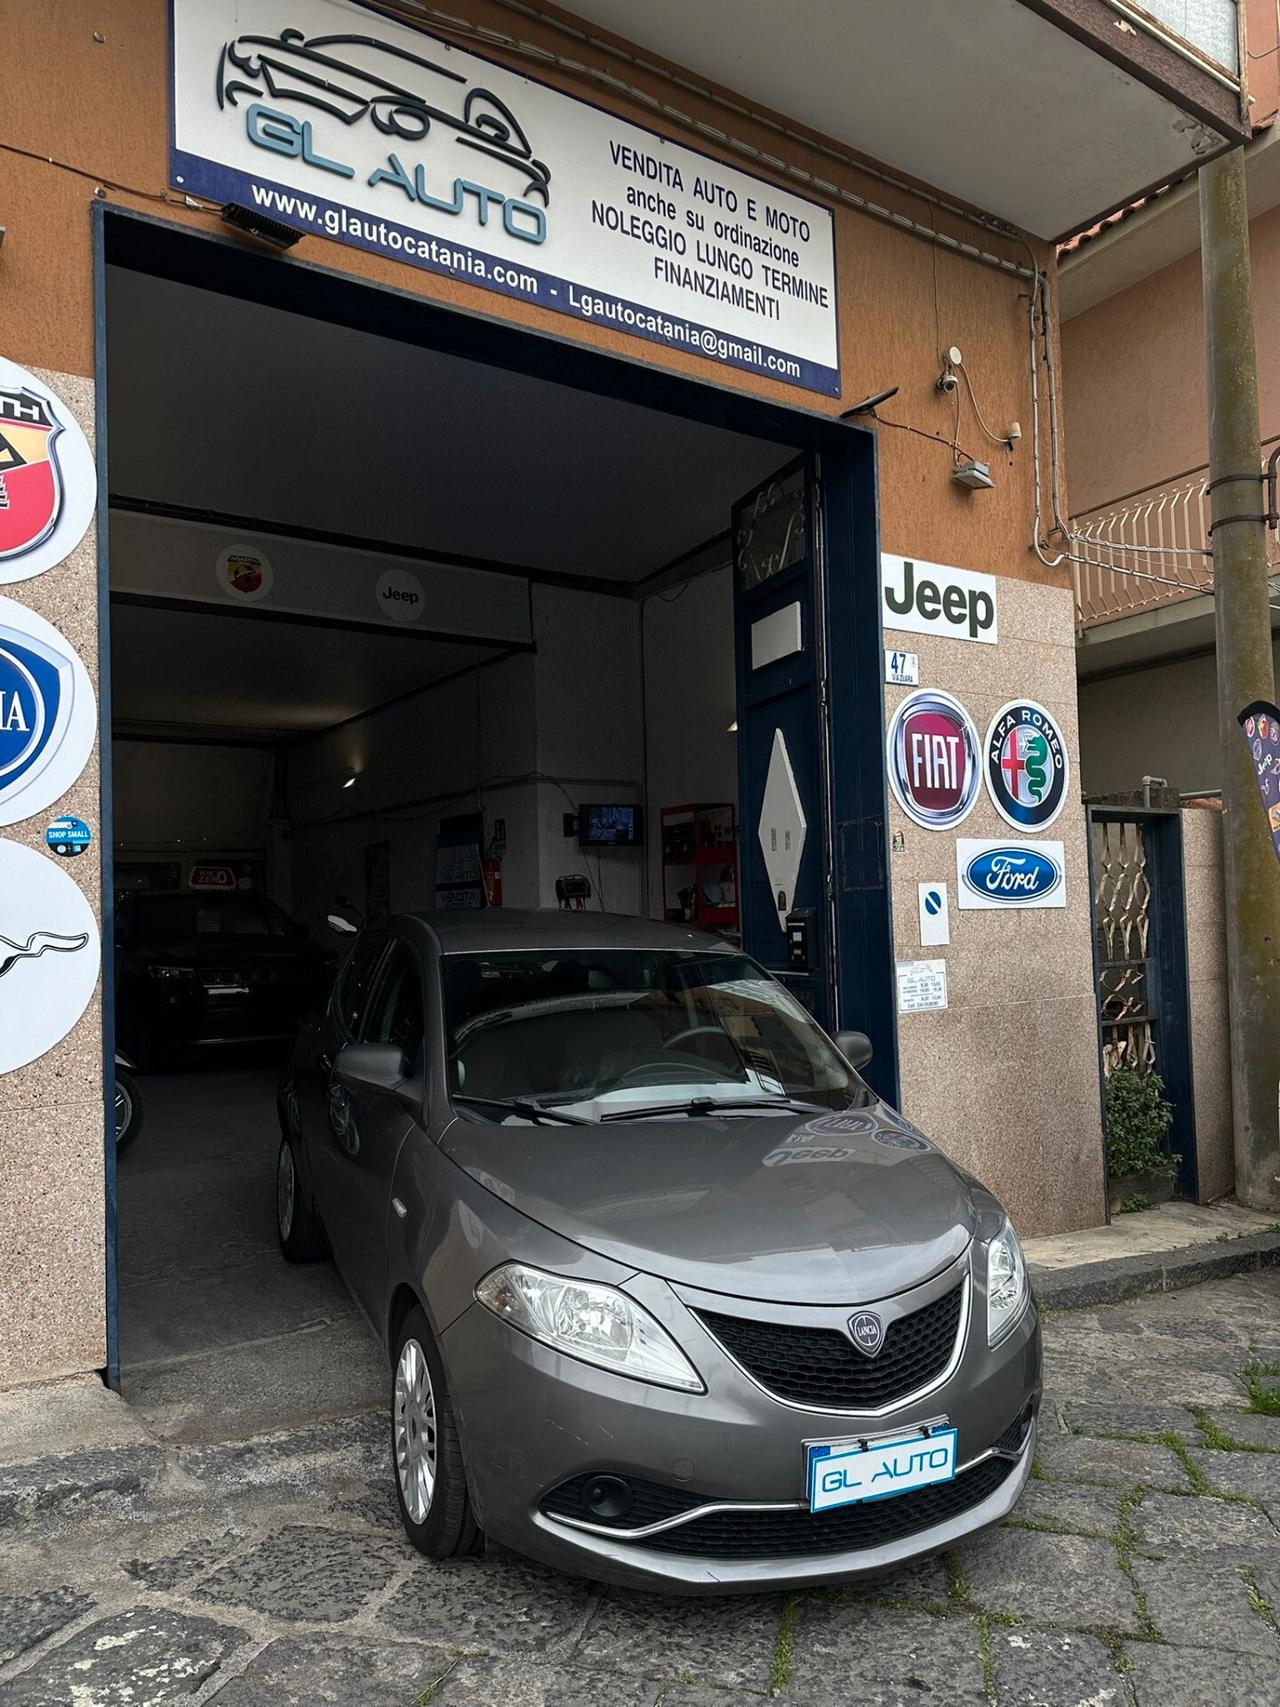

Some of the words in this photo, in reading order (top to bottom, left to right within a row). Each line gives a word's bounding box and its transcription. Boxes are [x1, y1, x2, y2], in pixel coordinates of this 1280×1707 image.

[246, 102, 355, 179] GL
[368, 153, 547, 245] AUTO
[610, 140, 684, 192] VENDITA
[693, 177, 738, 213] AUTO
[747, 199, 757, 221] E
[766, 206, 810, 242] MOTO
[592, 200, 687, 255] NOLEGGIO
[697, 240, 753, 280] LUNGO
[762, 264, 829, 308] TERMINE
[626, 186, 676, 220] anche
[686, 210, 705, 232] su
[714, 221, 800, 267] ordinazione
[251, 184, 538, 295] www.glautocatania.com
[569, 285, 801, 378] Lgautocatania@gmail.com
[654, 256, 781, 321] FINANZIAMENTI
[382, 586, 419, 605] Jeep
[884, 561, 995, 638] Jeep
[891, 652, 906, 674] 47
[911, 733, 959, 790] FIAT
[990, 716, 1017, 764] ALFA
[1021, 709, 1064, 770] ROMEO
[48, 830, 66, 839] SHOP
[67, 830, 89, 838] SMALL
[986, 855, 1039, 891] Ford
[857, 1325, 878, 1337] LANCIA
[821, 1469, 862, 1493] GL
[871, 1447, 948, 1484] AUTO
